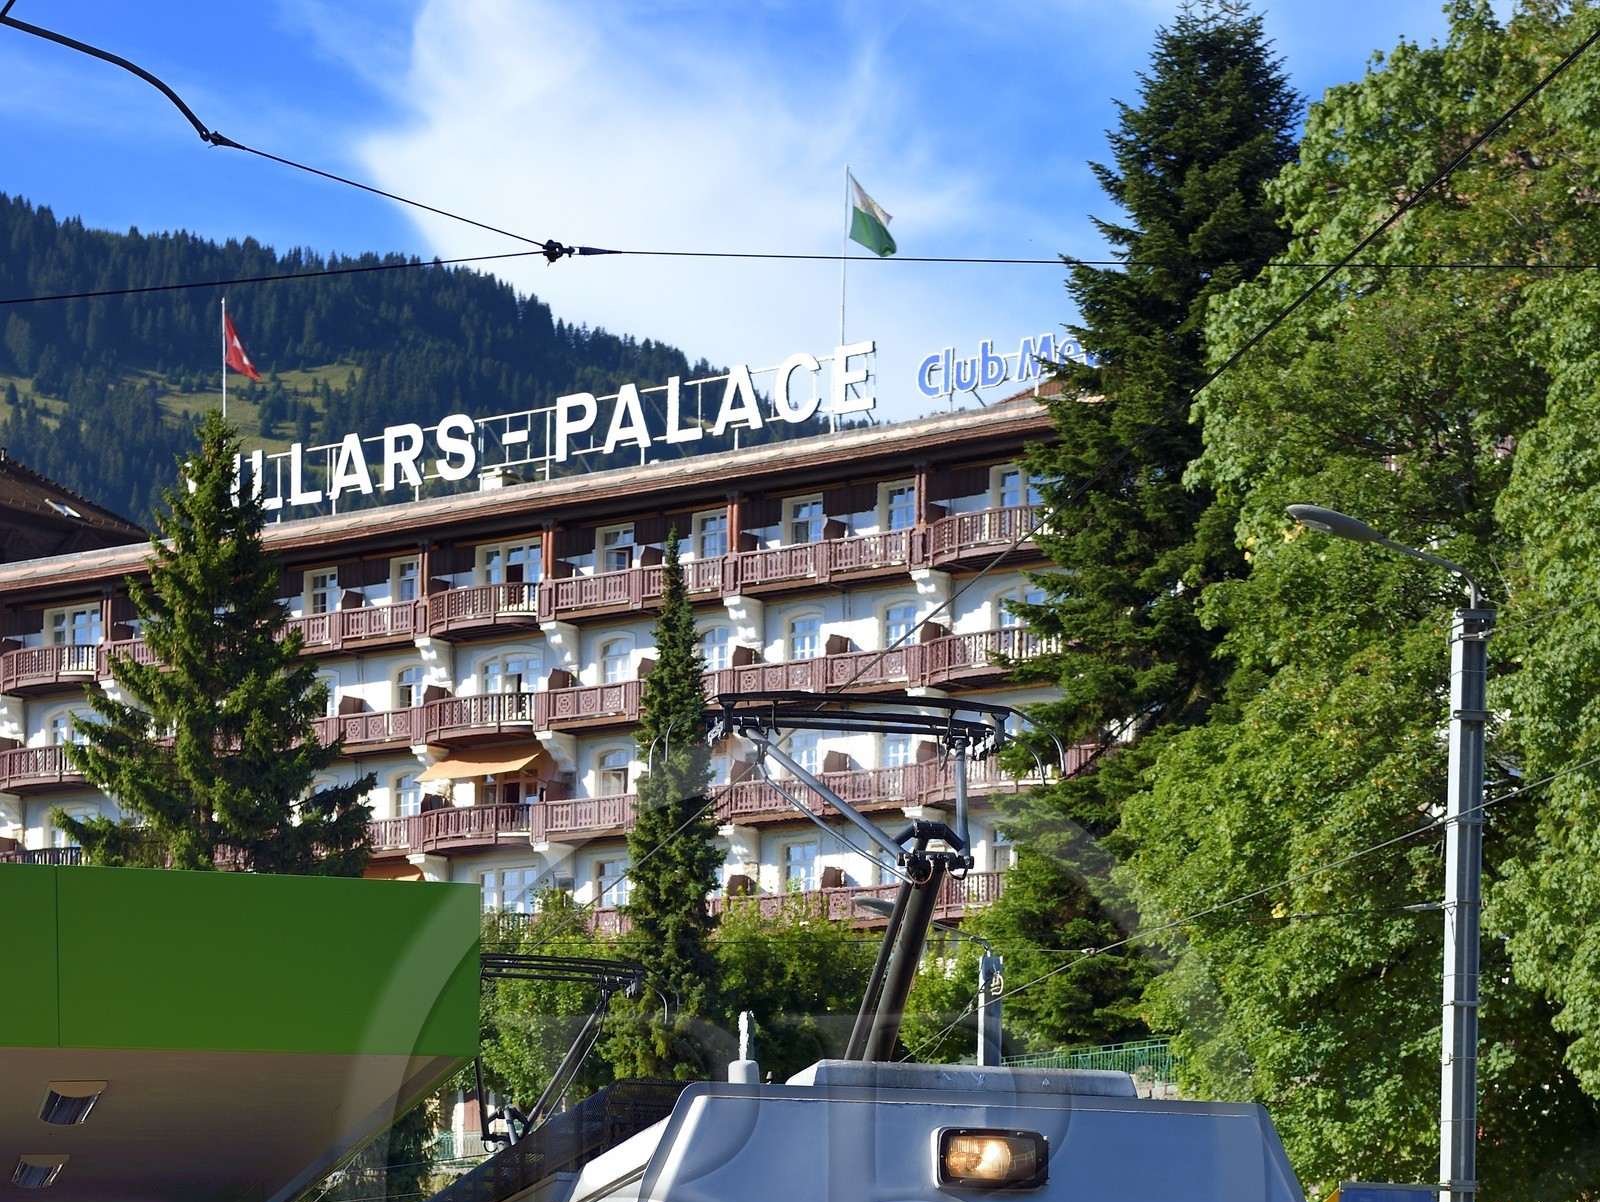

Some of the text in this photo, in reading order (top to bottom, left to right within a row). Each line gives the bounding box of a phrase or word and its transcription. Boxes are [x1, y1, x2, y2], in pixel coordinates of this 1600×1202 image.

[915, 332, 1104, 398] Club Me
[184, 412, 476, 510] ILLARS
[555, 340, 877, 462] PALACE
